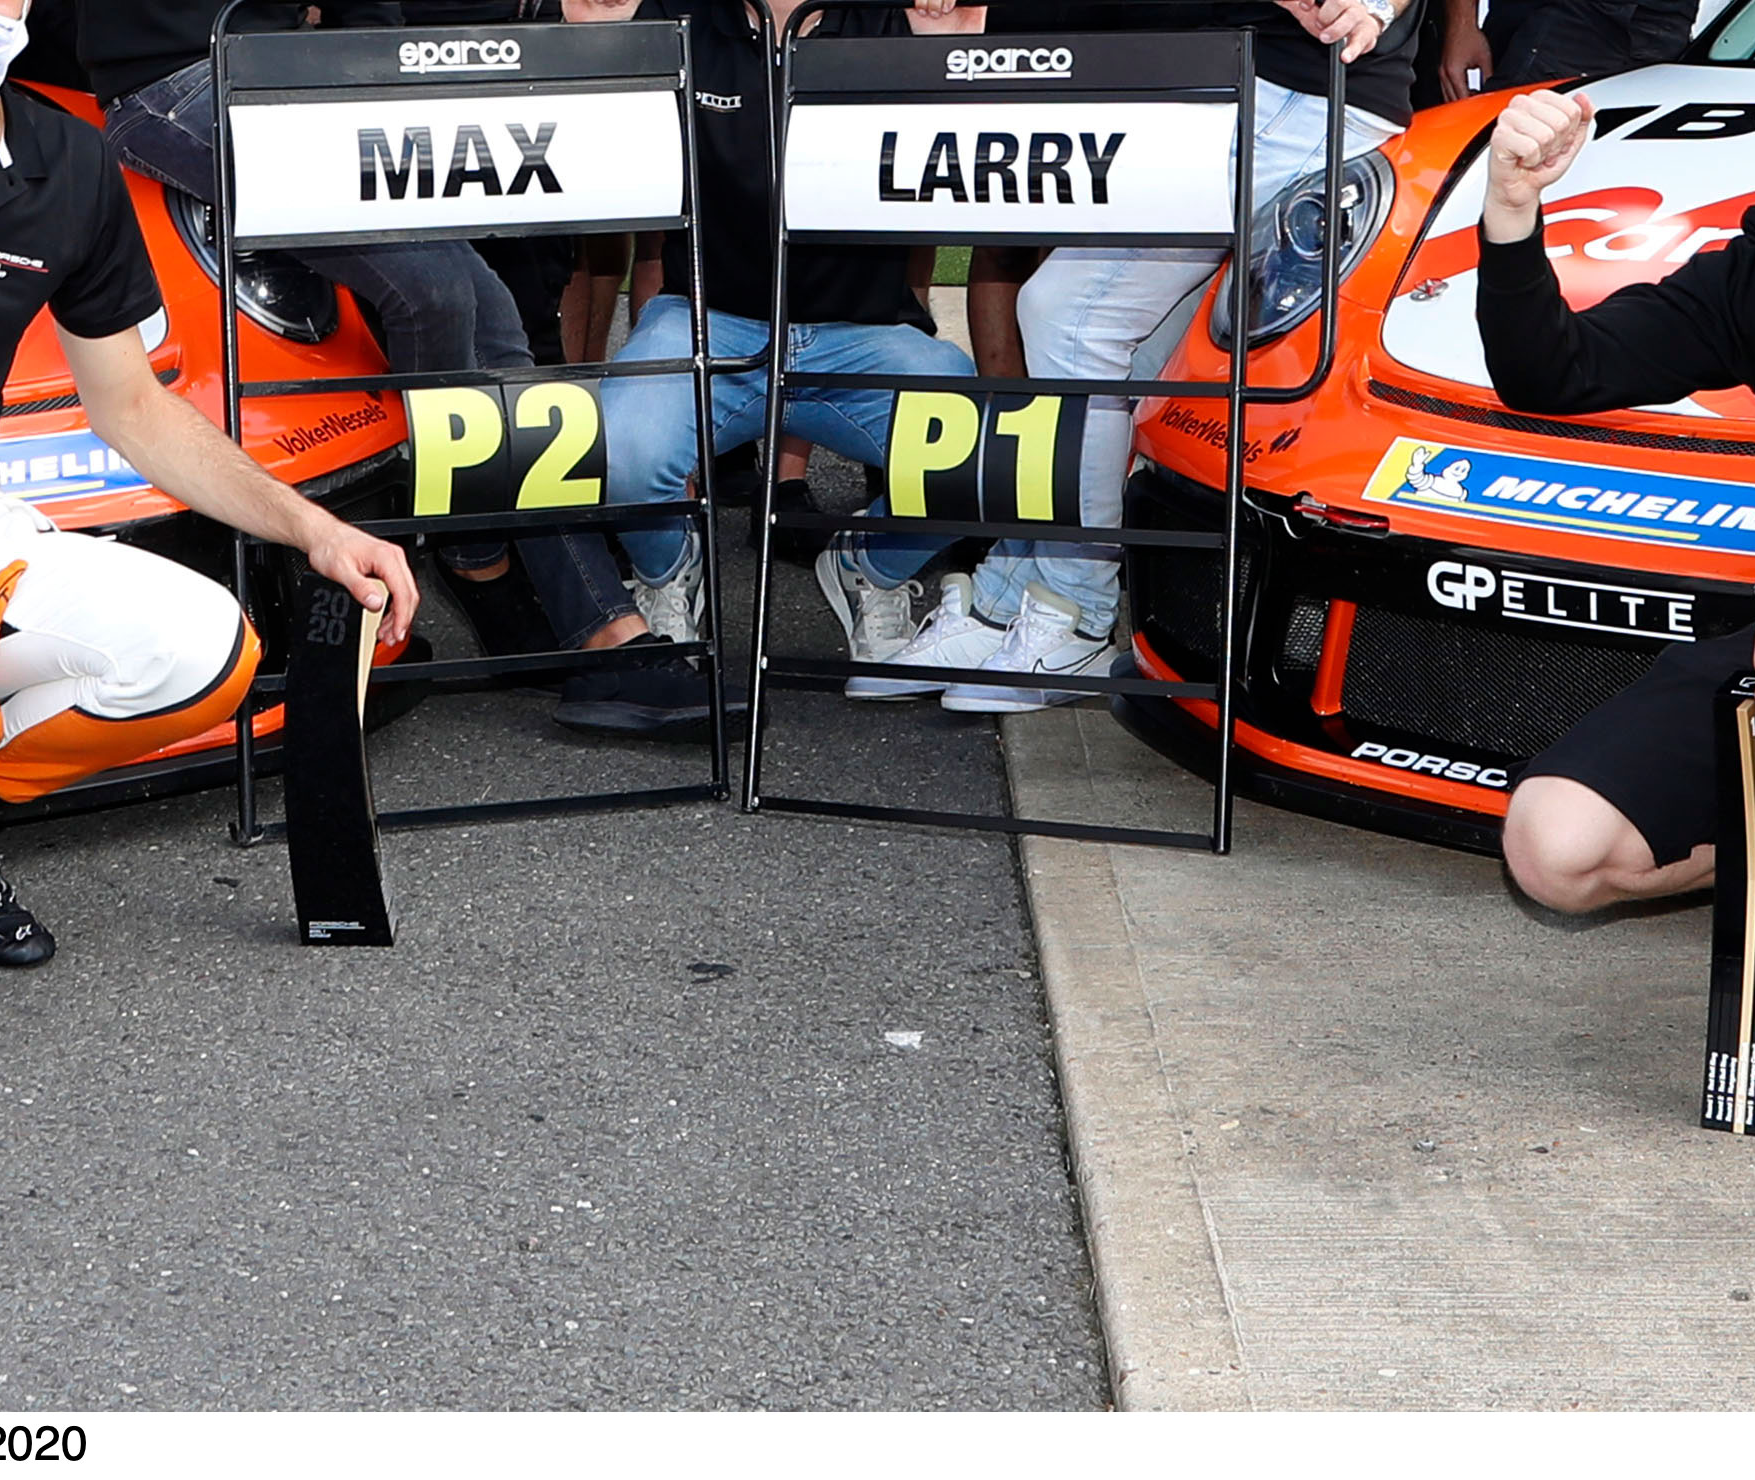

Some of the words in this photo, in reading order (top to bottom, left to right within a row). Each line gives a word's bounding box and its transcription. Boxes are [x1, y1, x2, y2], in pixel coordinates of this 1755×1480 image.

[398, 38, 521, 73] sparco
[945, 46, 1074, 80] sparco
[356, 121, 565, 202] MAX
[877, 131, 1127, 205] LARRY
[272, 400, 388, 458] VolkerWessels
[406, 382, 603, 518] P2
[888, 391, 1063, 522] P1
[1159, 402, 1263, 464] VolkerWesls
[1351, 741, 1508, 787] PORSC
